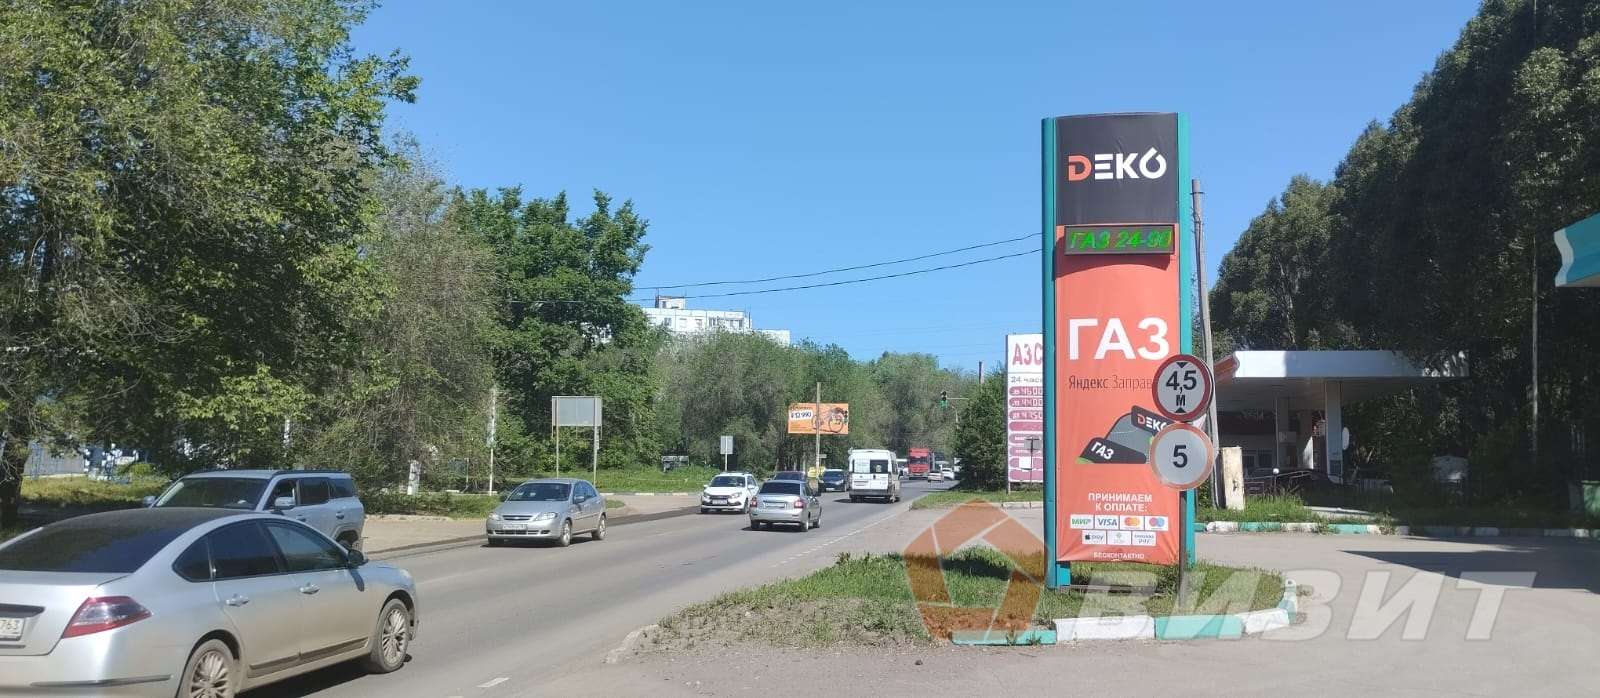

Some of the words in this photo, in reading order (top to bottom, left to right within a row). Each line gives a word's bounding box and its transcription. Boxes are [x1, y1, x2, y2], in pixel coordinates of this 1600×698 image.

[1068, 147, 1167, 181] DEKO
[1069, 229, 1111, 250] ГАЗ
[1069, 317, 1170, 361] ГАЗ
[1012, 343, 1042, 366] АЗС
[1068, 375, 1107, 390] Яндекс
[1112, 376, 1152, 391] Заправ
[1166, 370, 1197, 393] 4,5
[1176, 394, 1186, 406] М
[1091, 441, 1114, 459] ГАЗ
[1173, 445, 1188, 468] 5
[1088, 493, 1152, 502] ПРИНИМАЕМ
[1104, 503, 1147, 512] ОПЛАТЕ:
[1097, 518, 1117, 526] VISA
